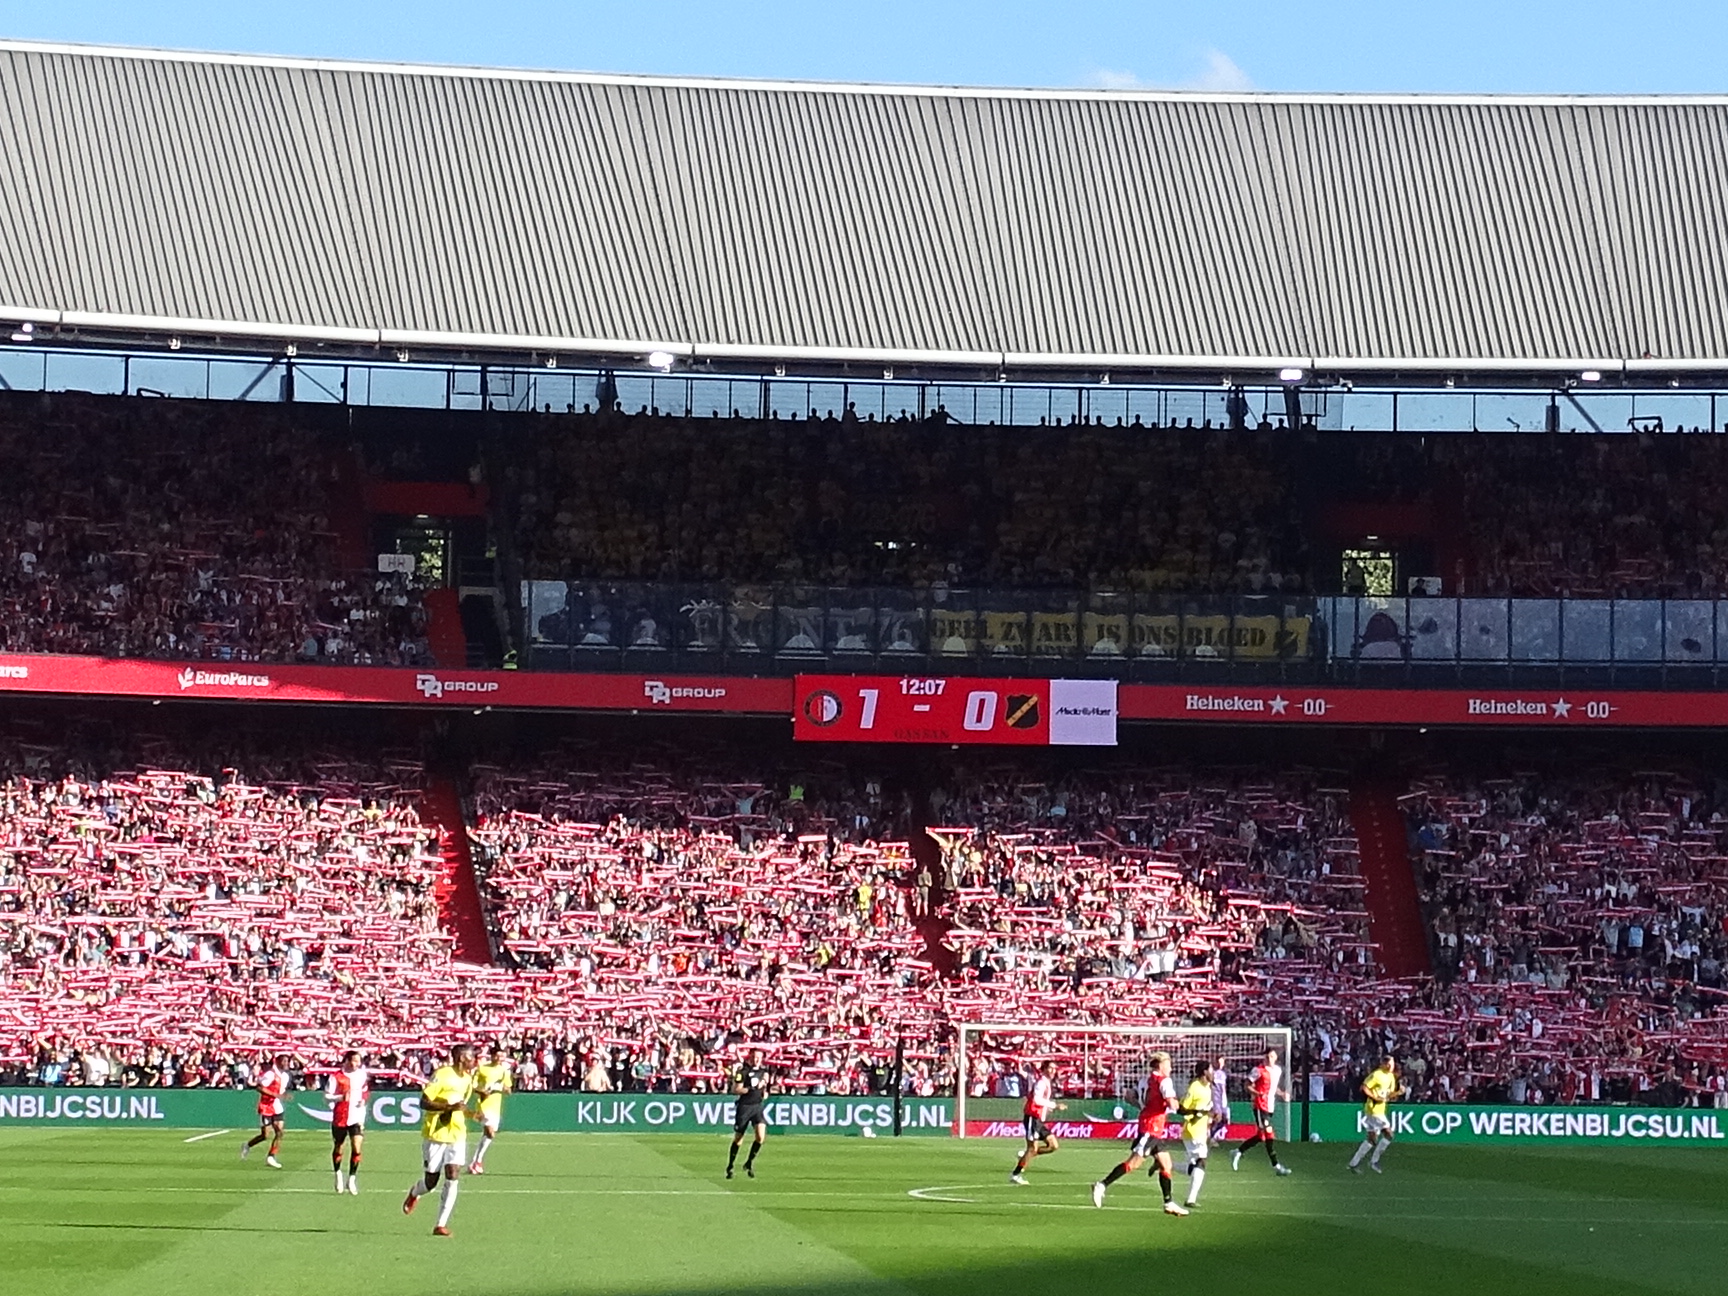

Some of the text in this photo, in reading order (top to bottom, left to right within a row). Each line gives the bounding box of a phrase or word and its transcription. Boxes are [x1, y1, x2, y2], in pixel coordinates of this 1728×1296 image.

[195, 670, 269, 688] EuroParcs
[444, 681, 499, 693] GROUP
[899, 679, 946, 695] 12:07
[672, 687, 726, 699] GROUP
[858, 688, 879, 729] 1
[963, 690, 998, 731] 0
[1186, 695, 1264, 712] Heineken
[1468, 699, 1547, 716] Heineken
[372, 1096, 422, 1124] CS
[577, 1100, 954, 1128] KIJK OP WEKENBIJCSU.NL
[1422, 1110, 1462, 1135] OP
[1469, 1112, 1726, 1139] WERKENBIJCSU.NL
